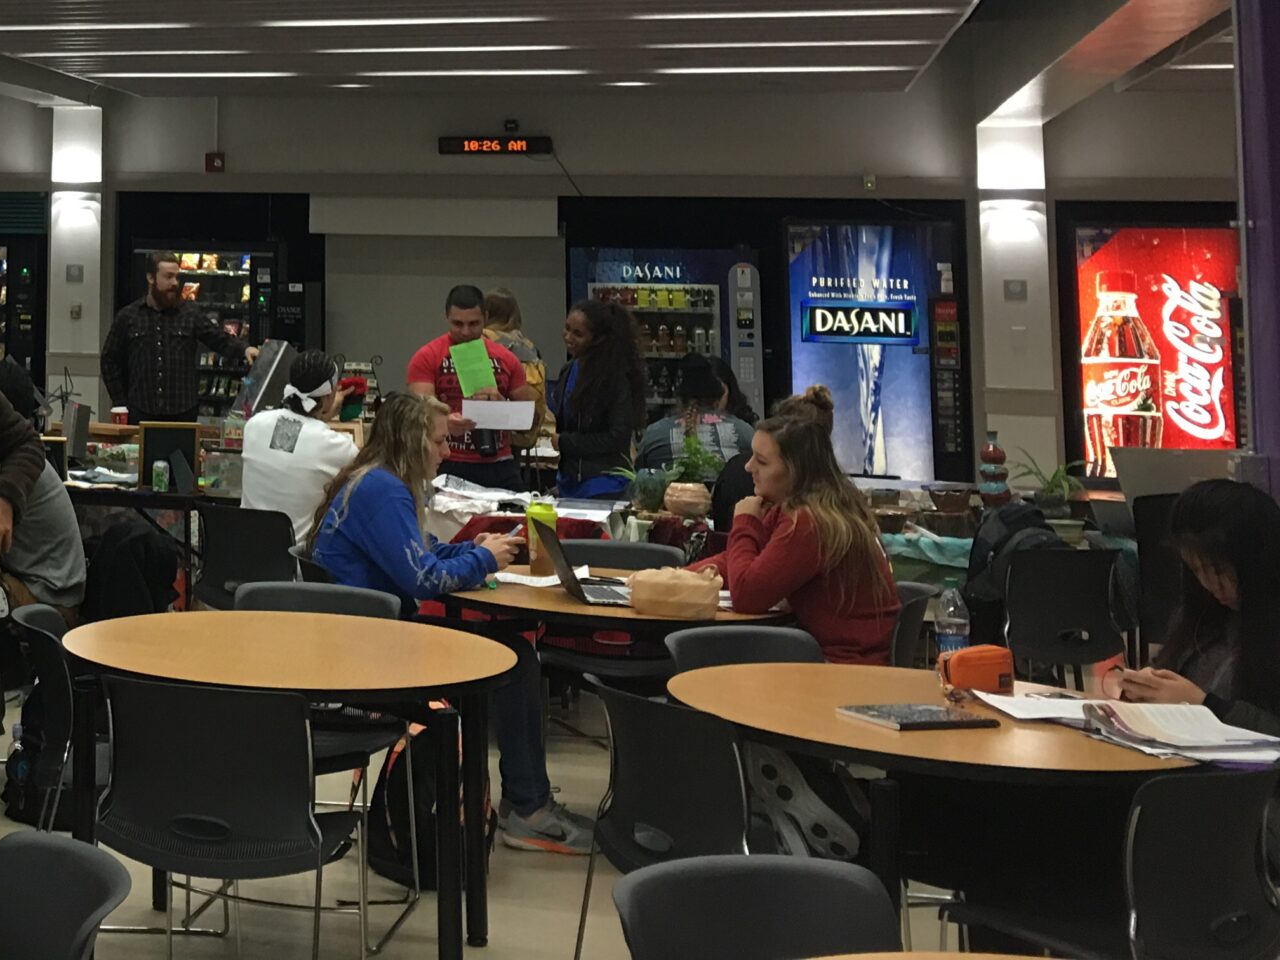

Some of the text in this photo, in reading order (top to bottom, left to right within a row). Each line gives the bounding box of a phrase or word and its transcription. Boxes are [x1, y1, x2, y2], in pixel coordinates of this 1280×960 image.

[463, 140, 527, 151] 10:26 AM
[622, 262, 681, 281] DASANI
[812, 276, 909, 290] PURIFIED WATER
[815, 308, 904, 335] DASANI
[1161, 273, 1226, 440] Coca-Cola
